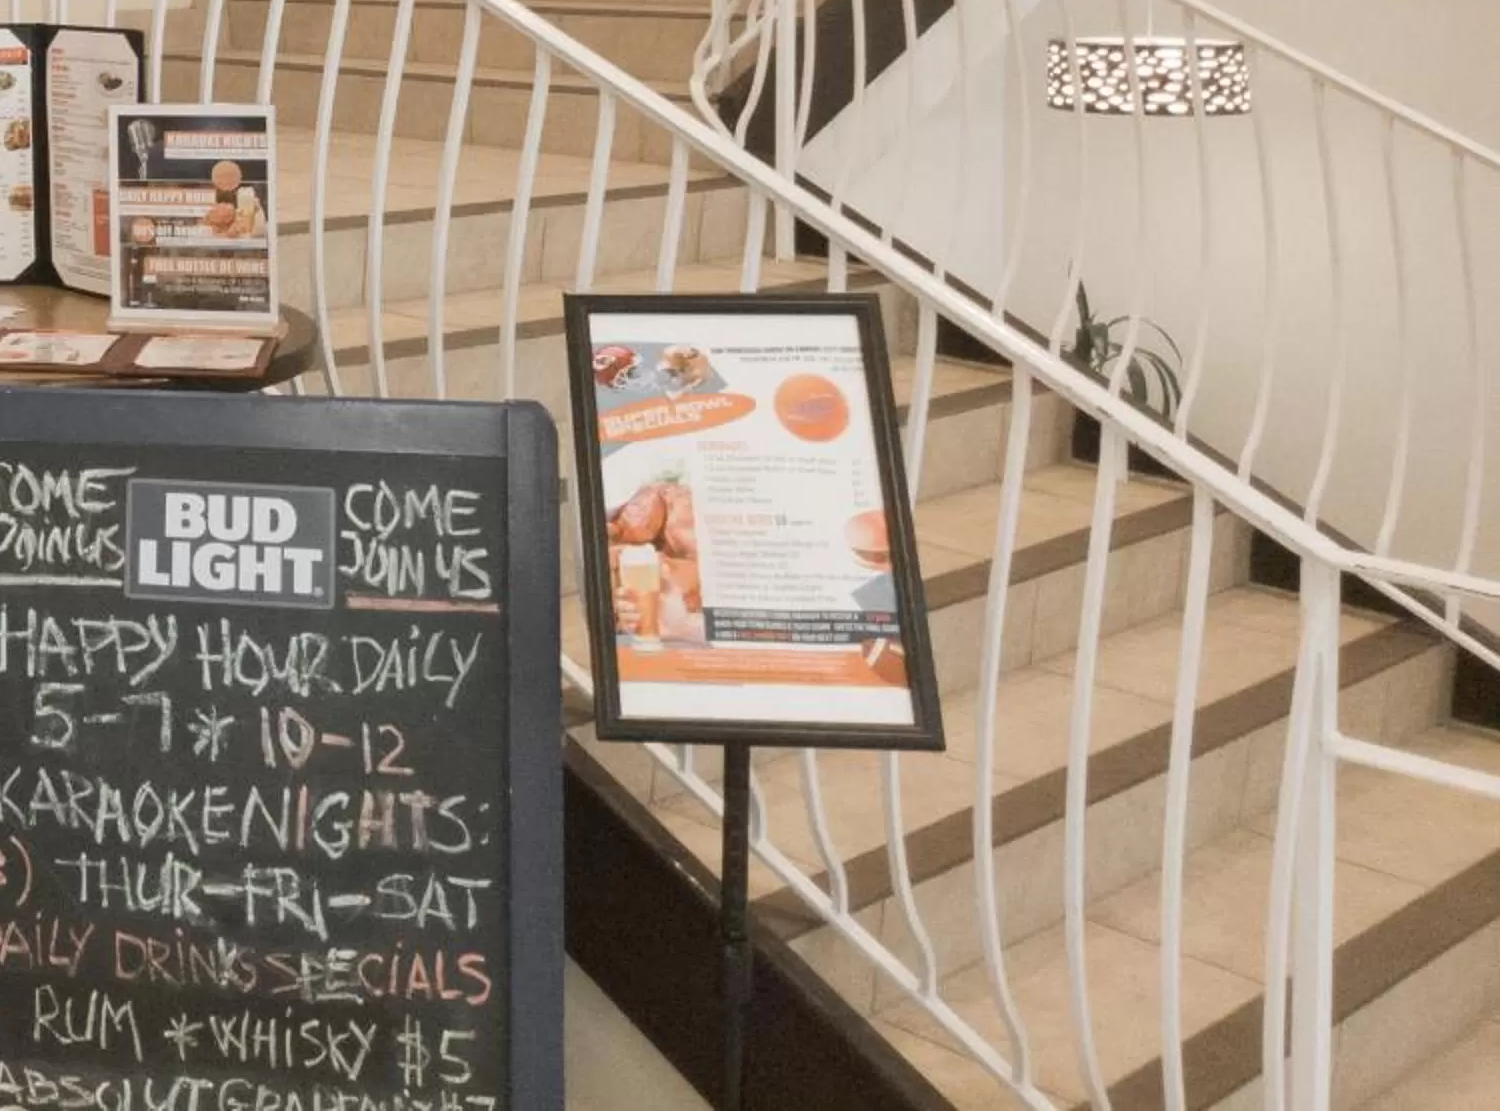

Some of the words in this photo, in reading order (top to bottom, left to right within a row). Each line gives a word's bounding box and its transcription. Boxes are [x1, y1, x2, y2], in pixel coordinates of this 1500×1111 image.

[164, 491, 298, 544] BUD
[344, 479, 482, 540] COME
[137, 537, 324, 595] LIGHT
[338, 529, 425, 597] JOIN
[434, 541, 493, 599] US
[195, 616, 345, 698] HOUR
[33, 983, 144, 1063] RUM
[396, 1014, 477, 1088] $5
